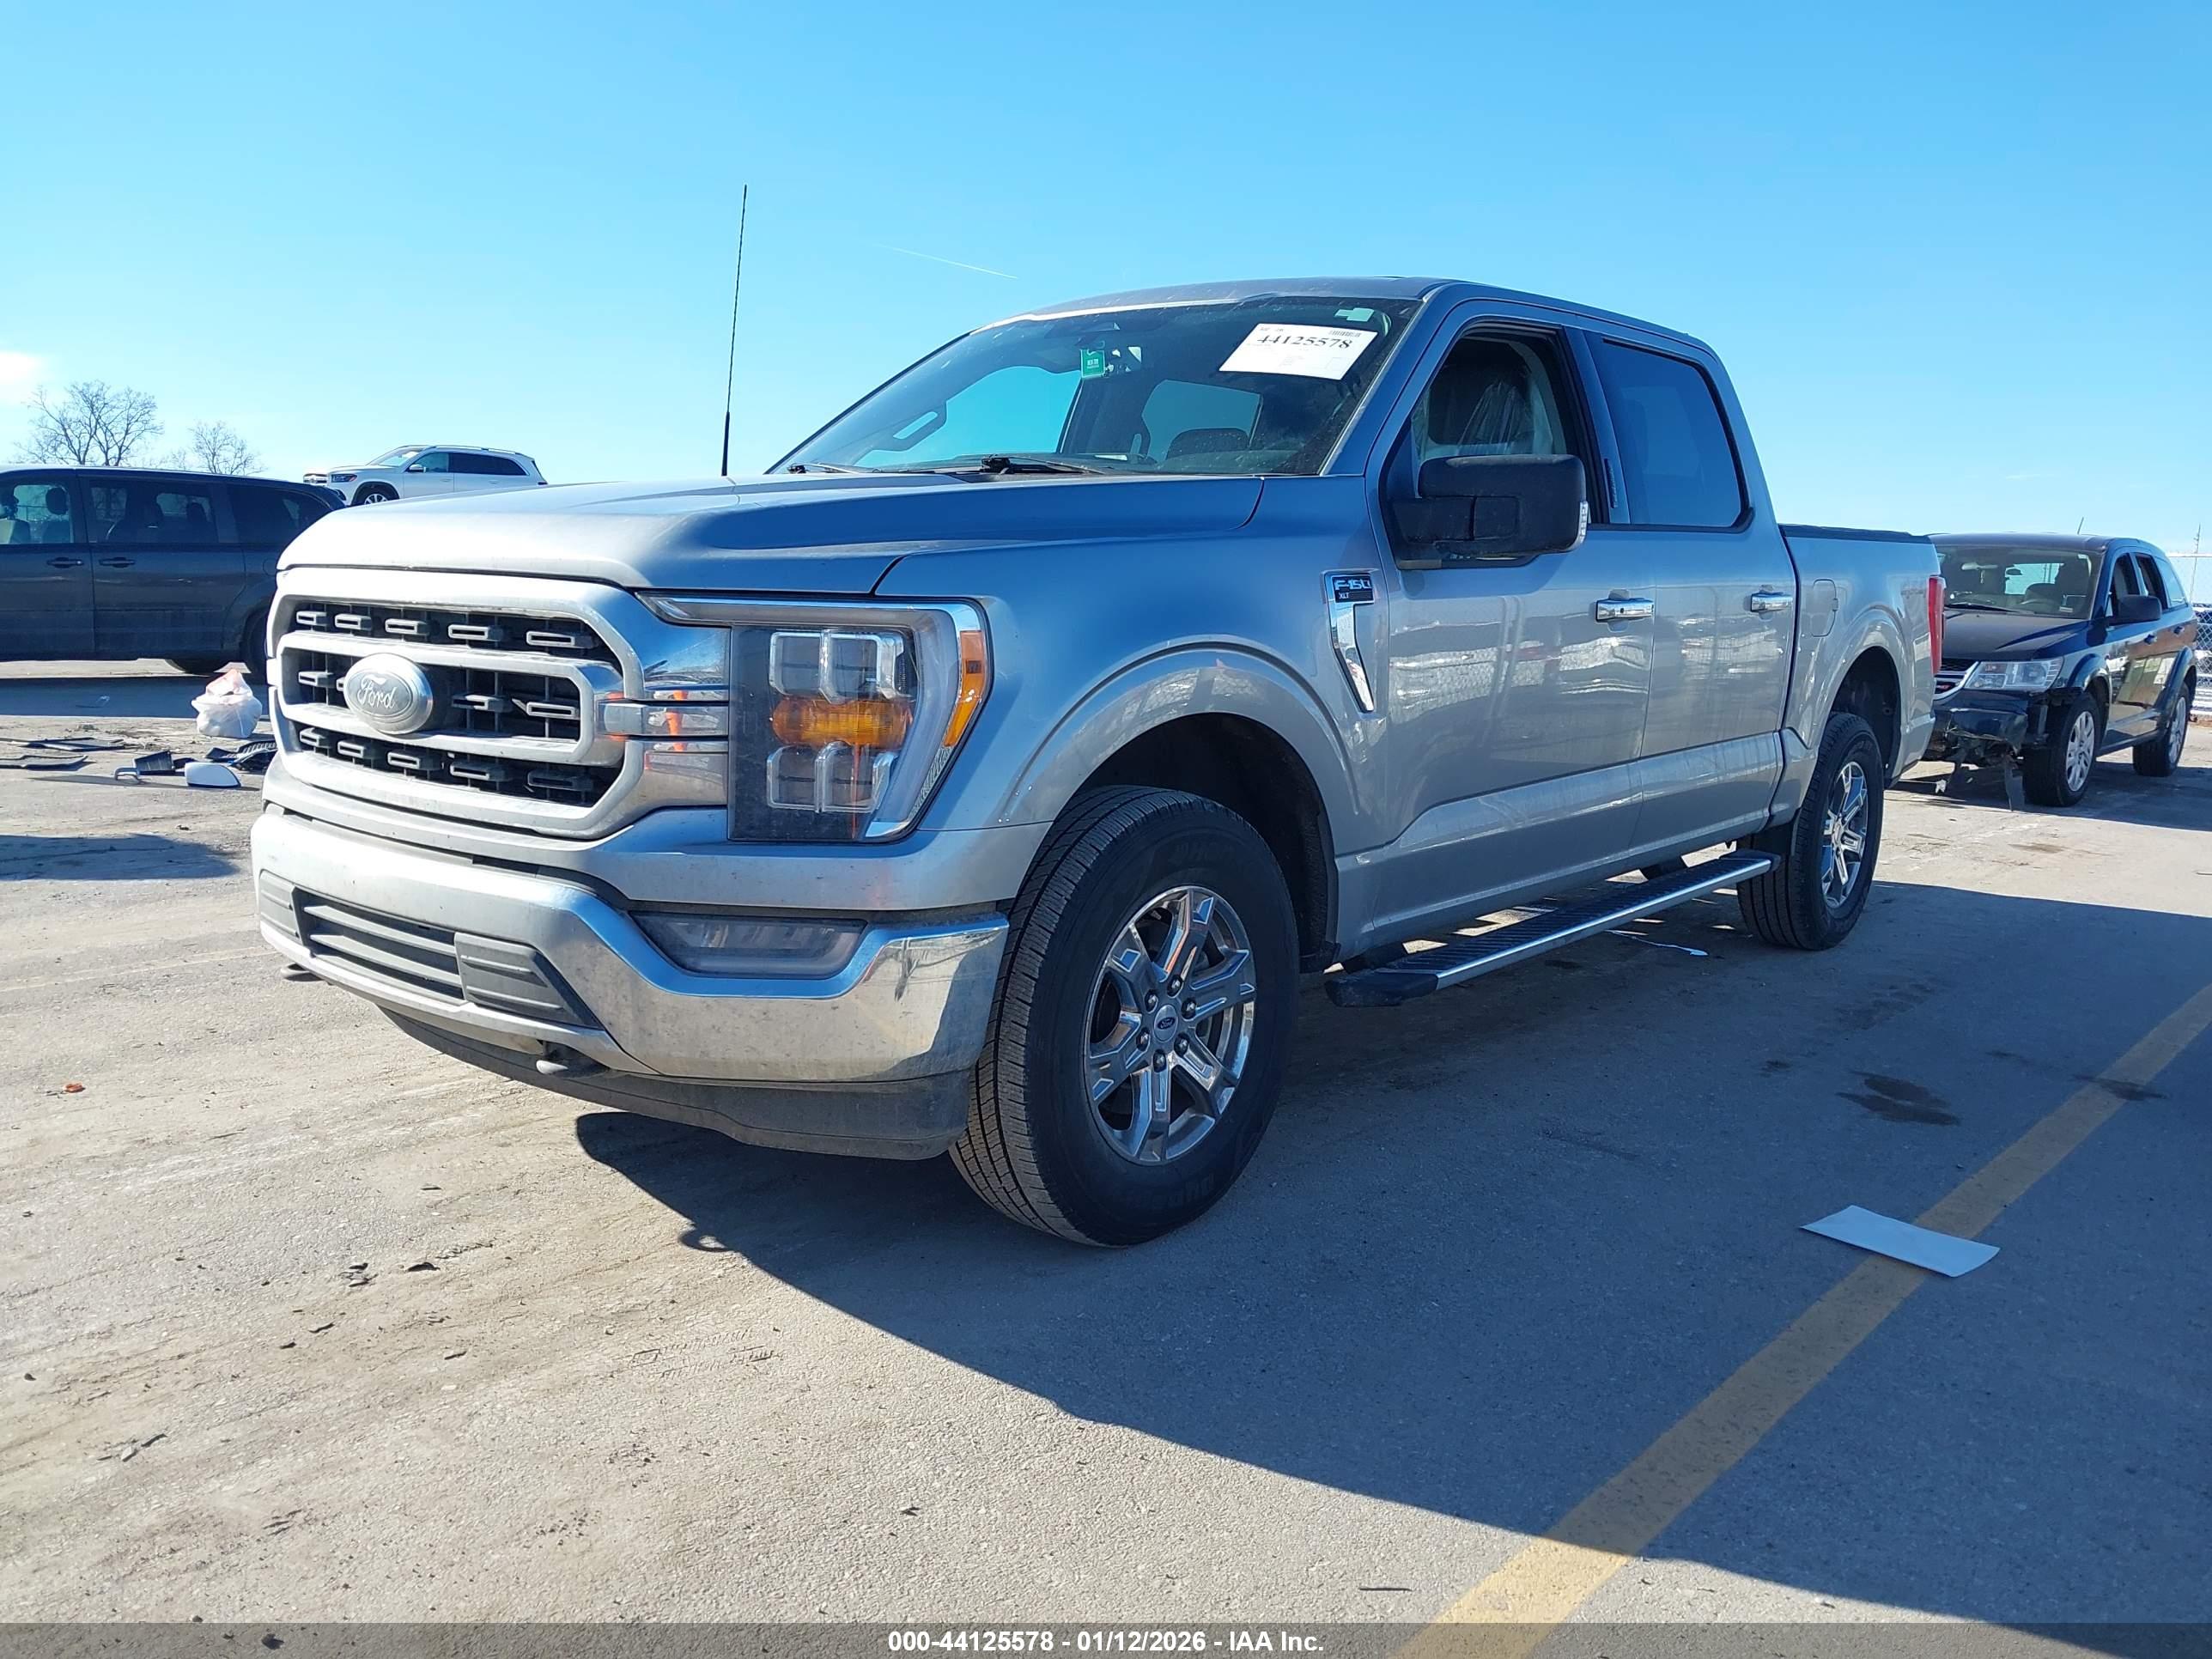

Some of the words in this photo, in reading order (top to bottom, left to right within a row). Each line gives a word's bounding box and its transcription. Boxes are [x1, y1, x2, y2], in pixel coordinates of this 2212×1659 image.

[1256, 334, 1353, 349] 44125578
[1334, 580, 1372, 590] F-150
[356, 674, 398, 708] Ford
